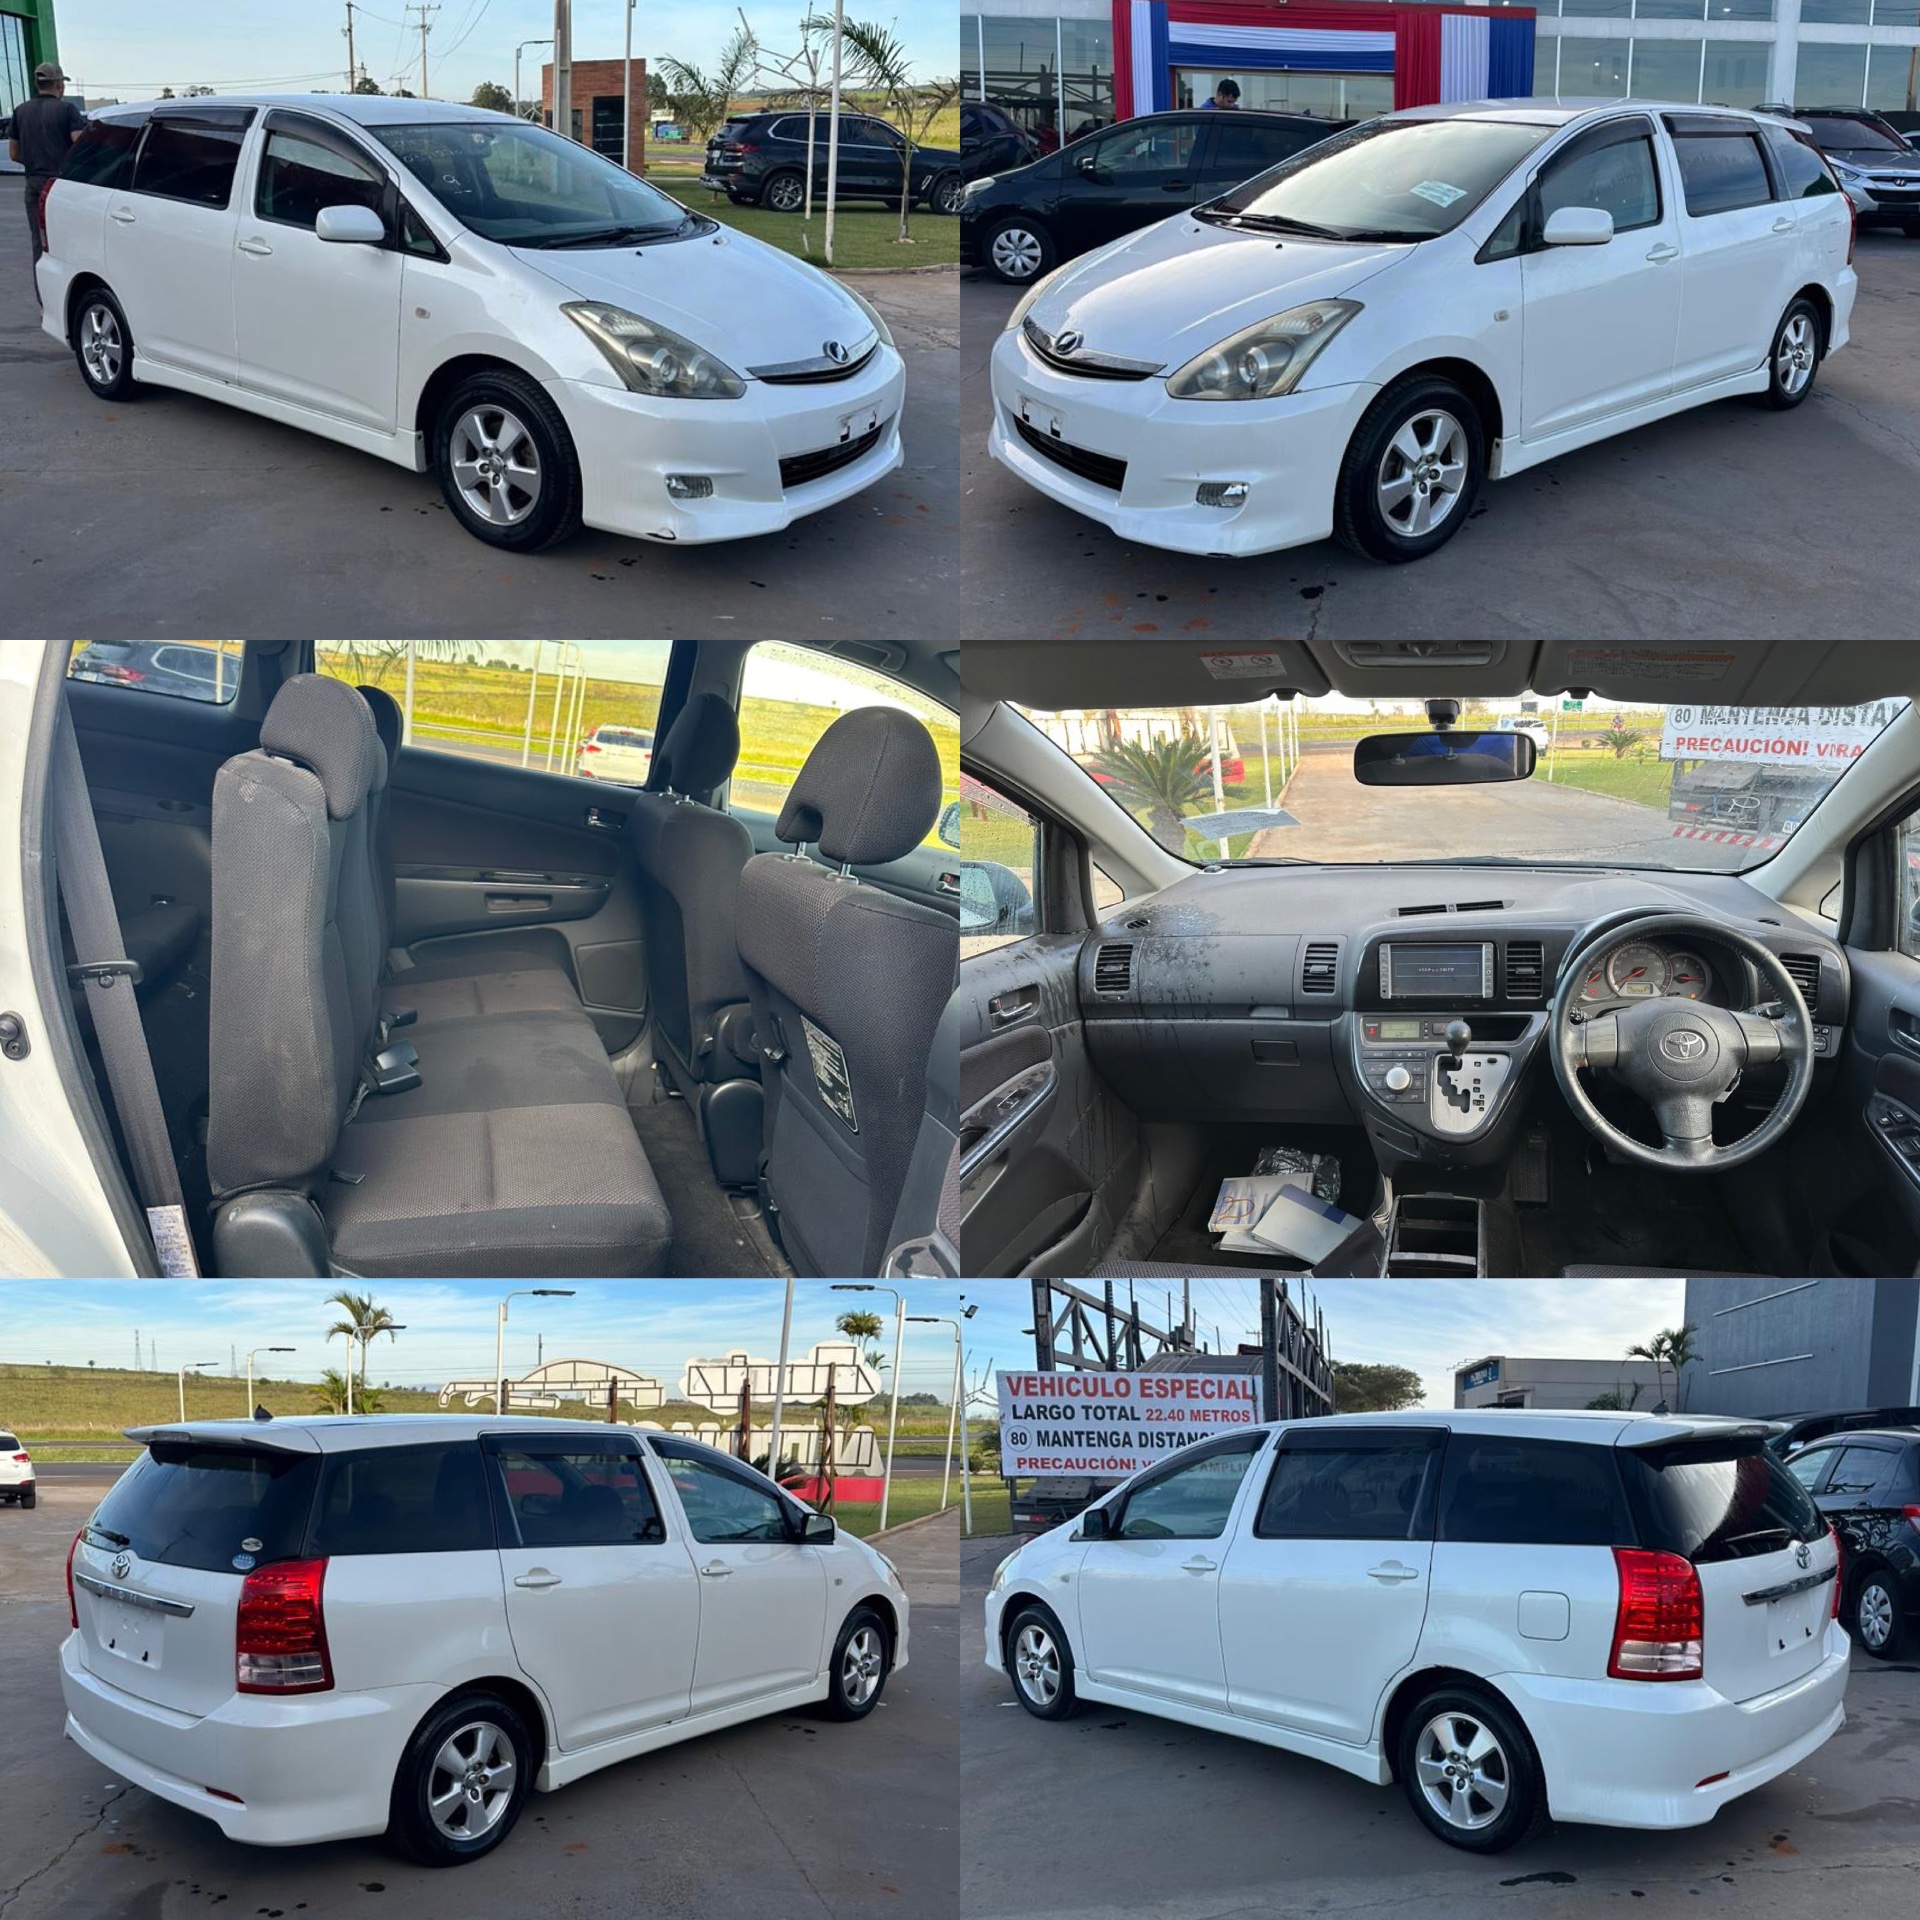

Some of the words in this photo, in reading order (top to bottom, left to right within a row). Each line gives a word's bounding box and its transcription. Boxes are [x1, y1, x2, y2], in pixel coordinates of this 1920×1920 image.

[1675, 708, 1691, 724] 80
[1675, 736, 1809, 756] PRECAUCIÓN!
[1005, 1375, 1131, 1398] VEHICULO
[1140, 1378, 1257, 1400] ESPECIAL
[1012, 1404, 1076, 1421] LARGO
[1081, 1405, 1141, 1421] TOTAL
[1145, 1408, 1185, 1422] 22.40
[1190, 1409, 1251, 1422] METROS
[1010, 1431, 1028, 1446] 80
[1036, 1430, 1133, 1448] MANTENGA
[1138, 1431, 1215, 1448] DISTANC
[1016, 1455, 1137, 1471] PRECAUCIÓN!
